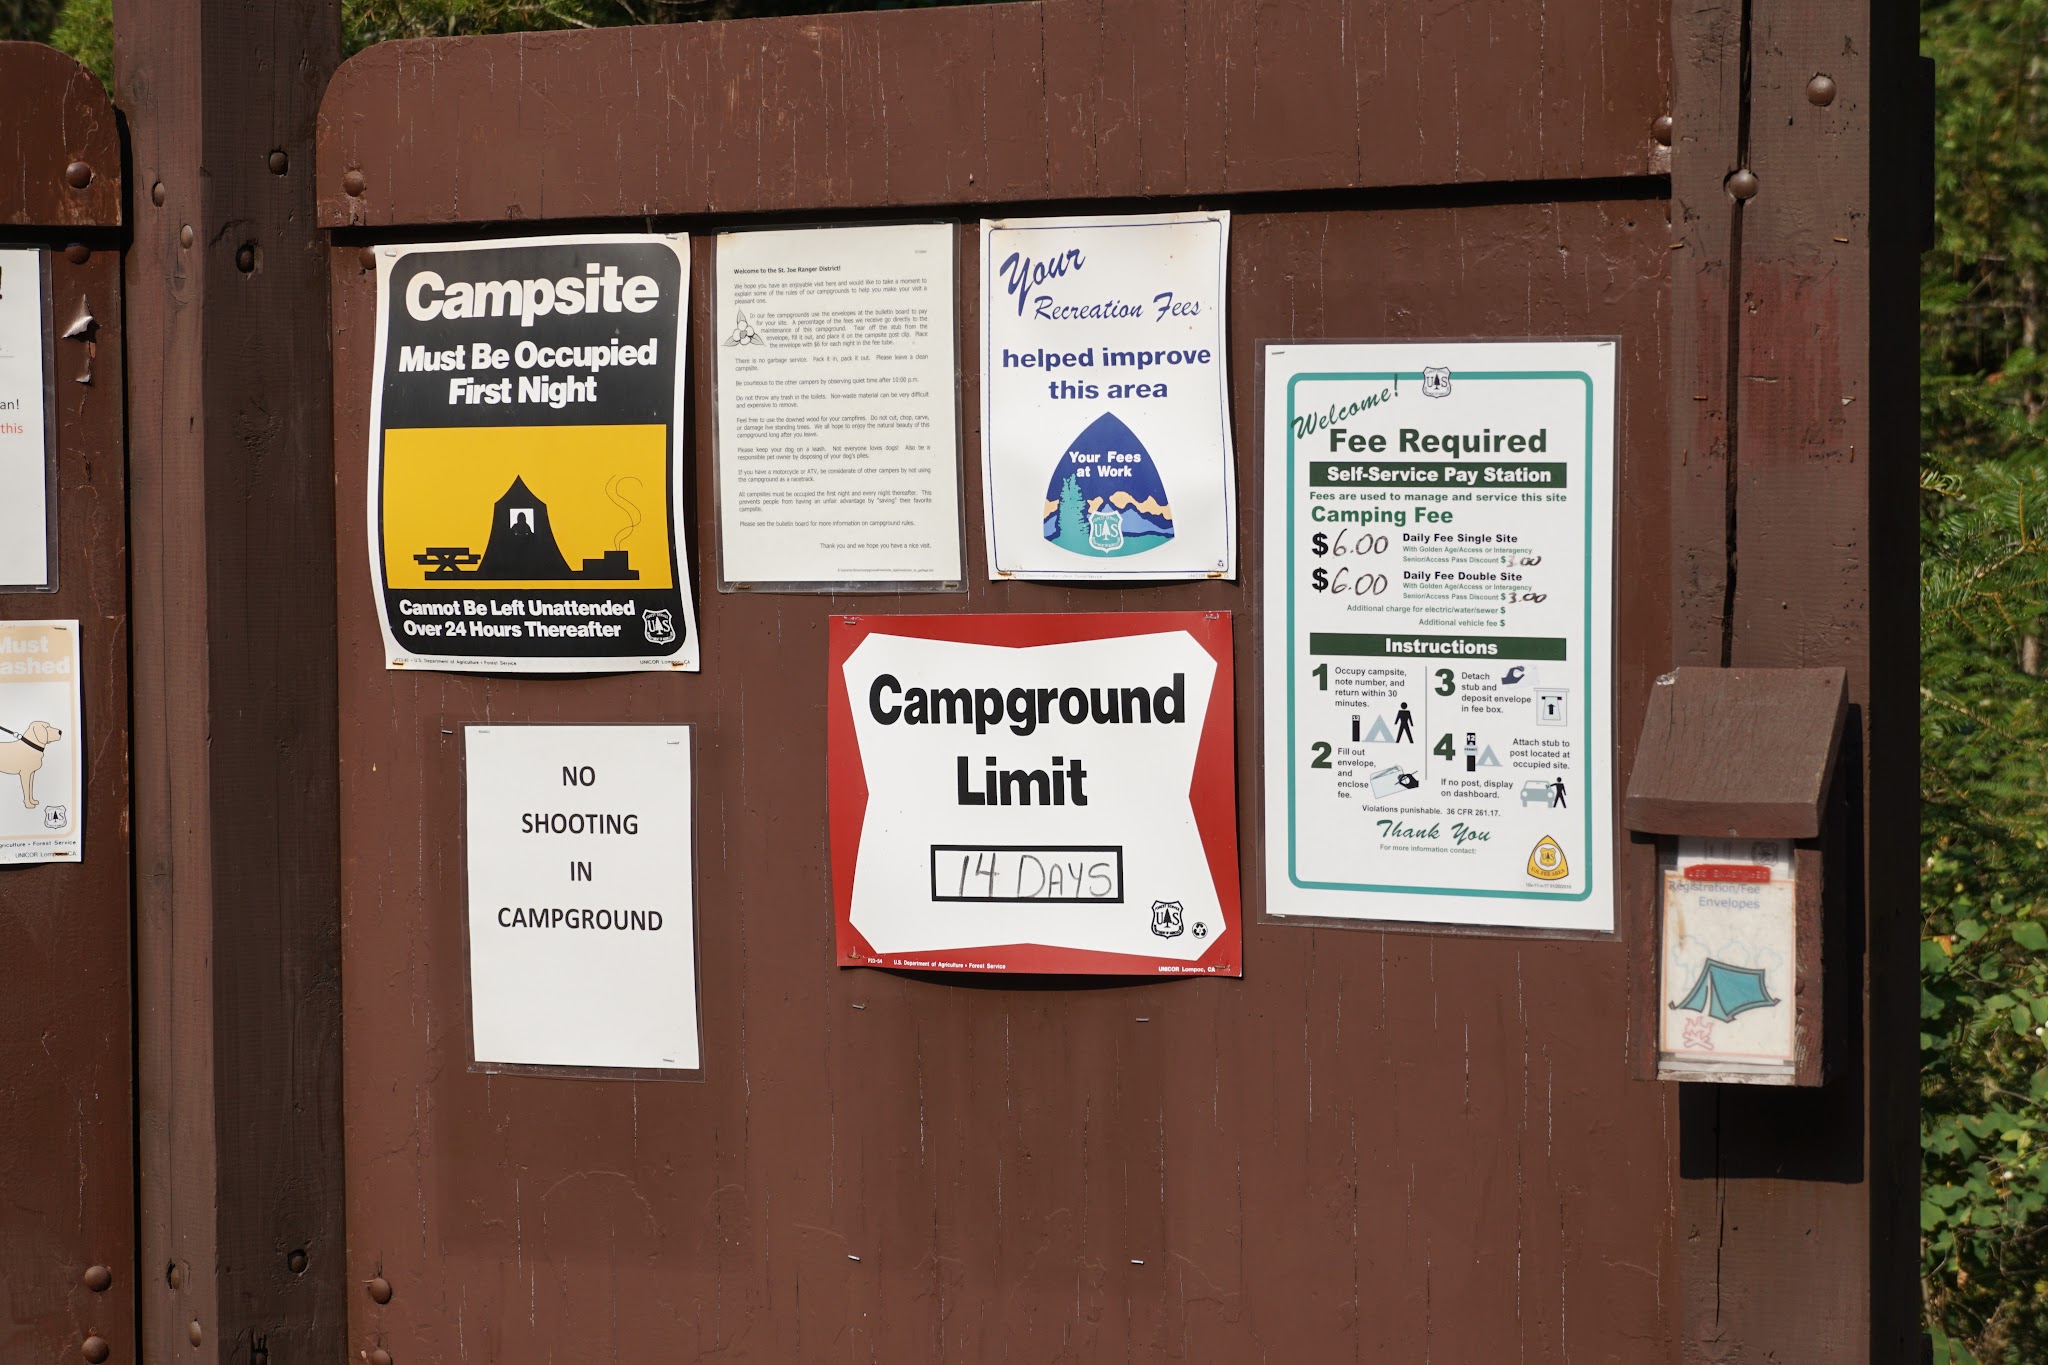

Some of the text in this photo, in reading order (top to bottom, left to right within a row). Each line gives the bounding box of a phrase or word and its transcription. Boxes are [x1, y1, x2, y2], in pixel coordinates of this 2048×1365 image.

[1000, 249, 1085, 316] Your
[406, 263, 659, 327] Campsite
[1034, 292, 1200, 322] Recreation Fees
[399, 338, 657, 372] Must Be Occupied
[1003, 348, 1210, 371] helped improve
[449, 375, 597, 408] First Night
[1049, 380, 1167, 399] this area
[1291, 374, 1399, 439] Welcome!
[1, 423, 23, 433] this
[1330, 429, 1546, 459] Fee Required
[1069, 451, 1141, 463] Your Fees
[1077, 465, 1132, 477] at Work
[1328, 466, 1551, 485] Self-Service Pay Station
[1310, 492, 1335, 500] Fees
[1361, 492, 1386, 500] used
[1405, 495, 1448, 503] manage
[1452, 493, 1472, 501] and
[1476, 493, 1517, 501] service
[1522, 493, 1542, 501] this
[1546, 493, 1566, 501] site
[1312, 506, 1453, 527] Camping Fee
[1403, 534, 1517, 544] Daily Fee Single Site
[1494, 547, 1532, 555] Interagency
[1404, 571, 1522, 581] Daily Fee Double Site
[400, 599, 635, 616] Cannot Be Left Unattended
[404, 620, 621, 637] Over 24 Hours Thereafter
[1386, 638, 1498, 655] Instructions
[1313, 664, 1327, 691] 1
[1335, 667, 1406, 677] Occupy campsite,
[1462, 672, 1489, 680] Detach
[1355, 679, 1387, 687] number,
[1435, 669, 1455, 696] 3
[869, 673, 1185, 736] Campground
[1462, 694, 1531, 704] deposit envelope
[1311, 742, 1332, 769] 2
[1434, 733, 1455, 761] 4
[1338, 759, 1376, 768] envelope,
[1513, 761, 1550, 769] occupied
[563, 766, 595, 786] NO
[957, 756, 1087, 806] Limit
[1484, 780, 1513, 789] display
[1454, 790, 1499, 798] dashboard.
[522, 813, 637, 834] SHOOTING
[1377, 820, 1490, 845] Thank You
[571, 861, 591, 881] IN
[958, 852, 999, 898] 14
[1669, 881, 1760, 893] Registration/Fee
[1699, 896, 1760, 910] Envelopes
[498, 908, 662, 930] CAMPGROUND
